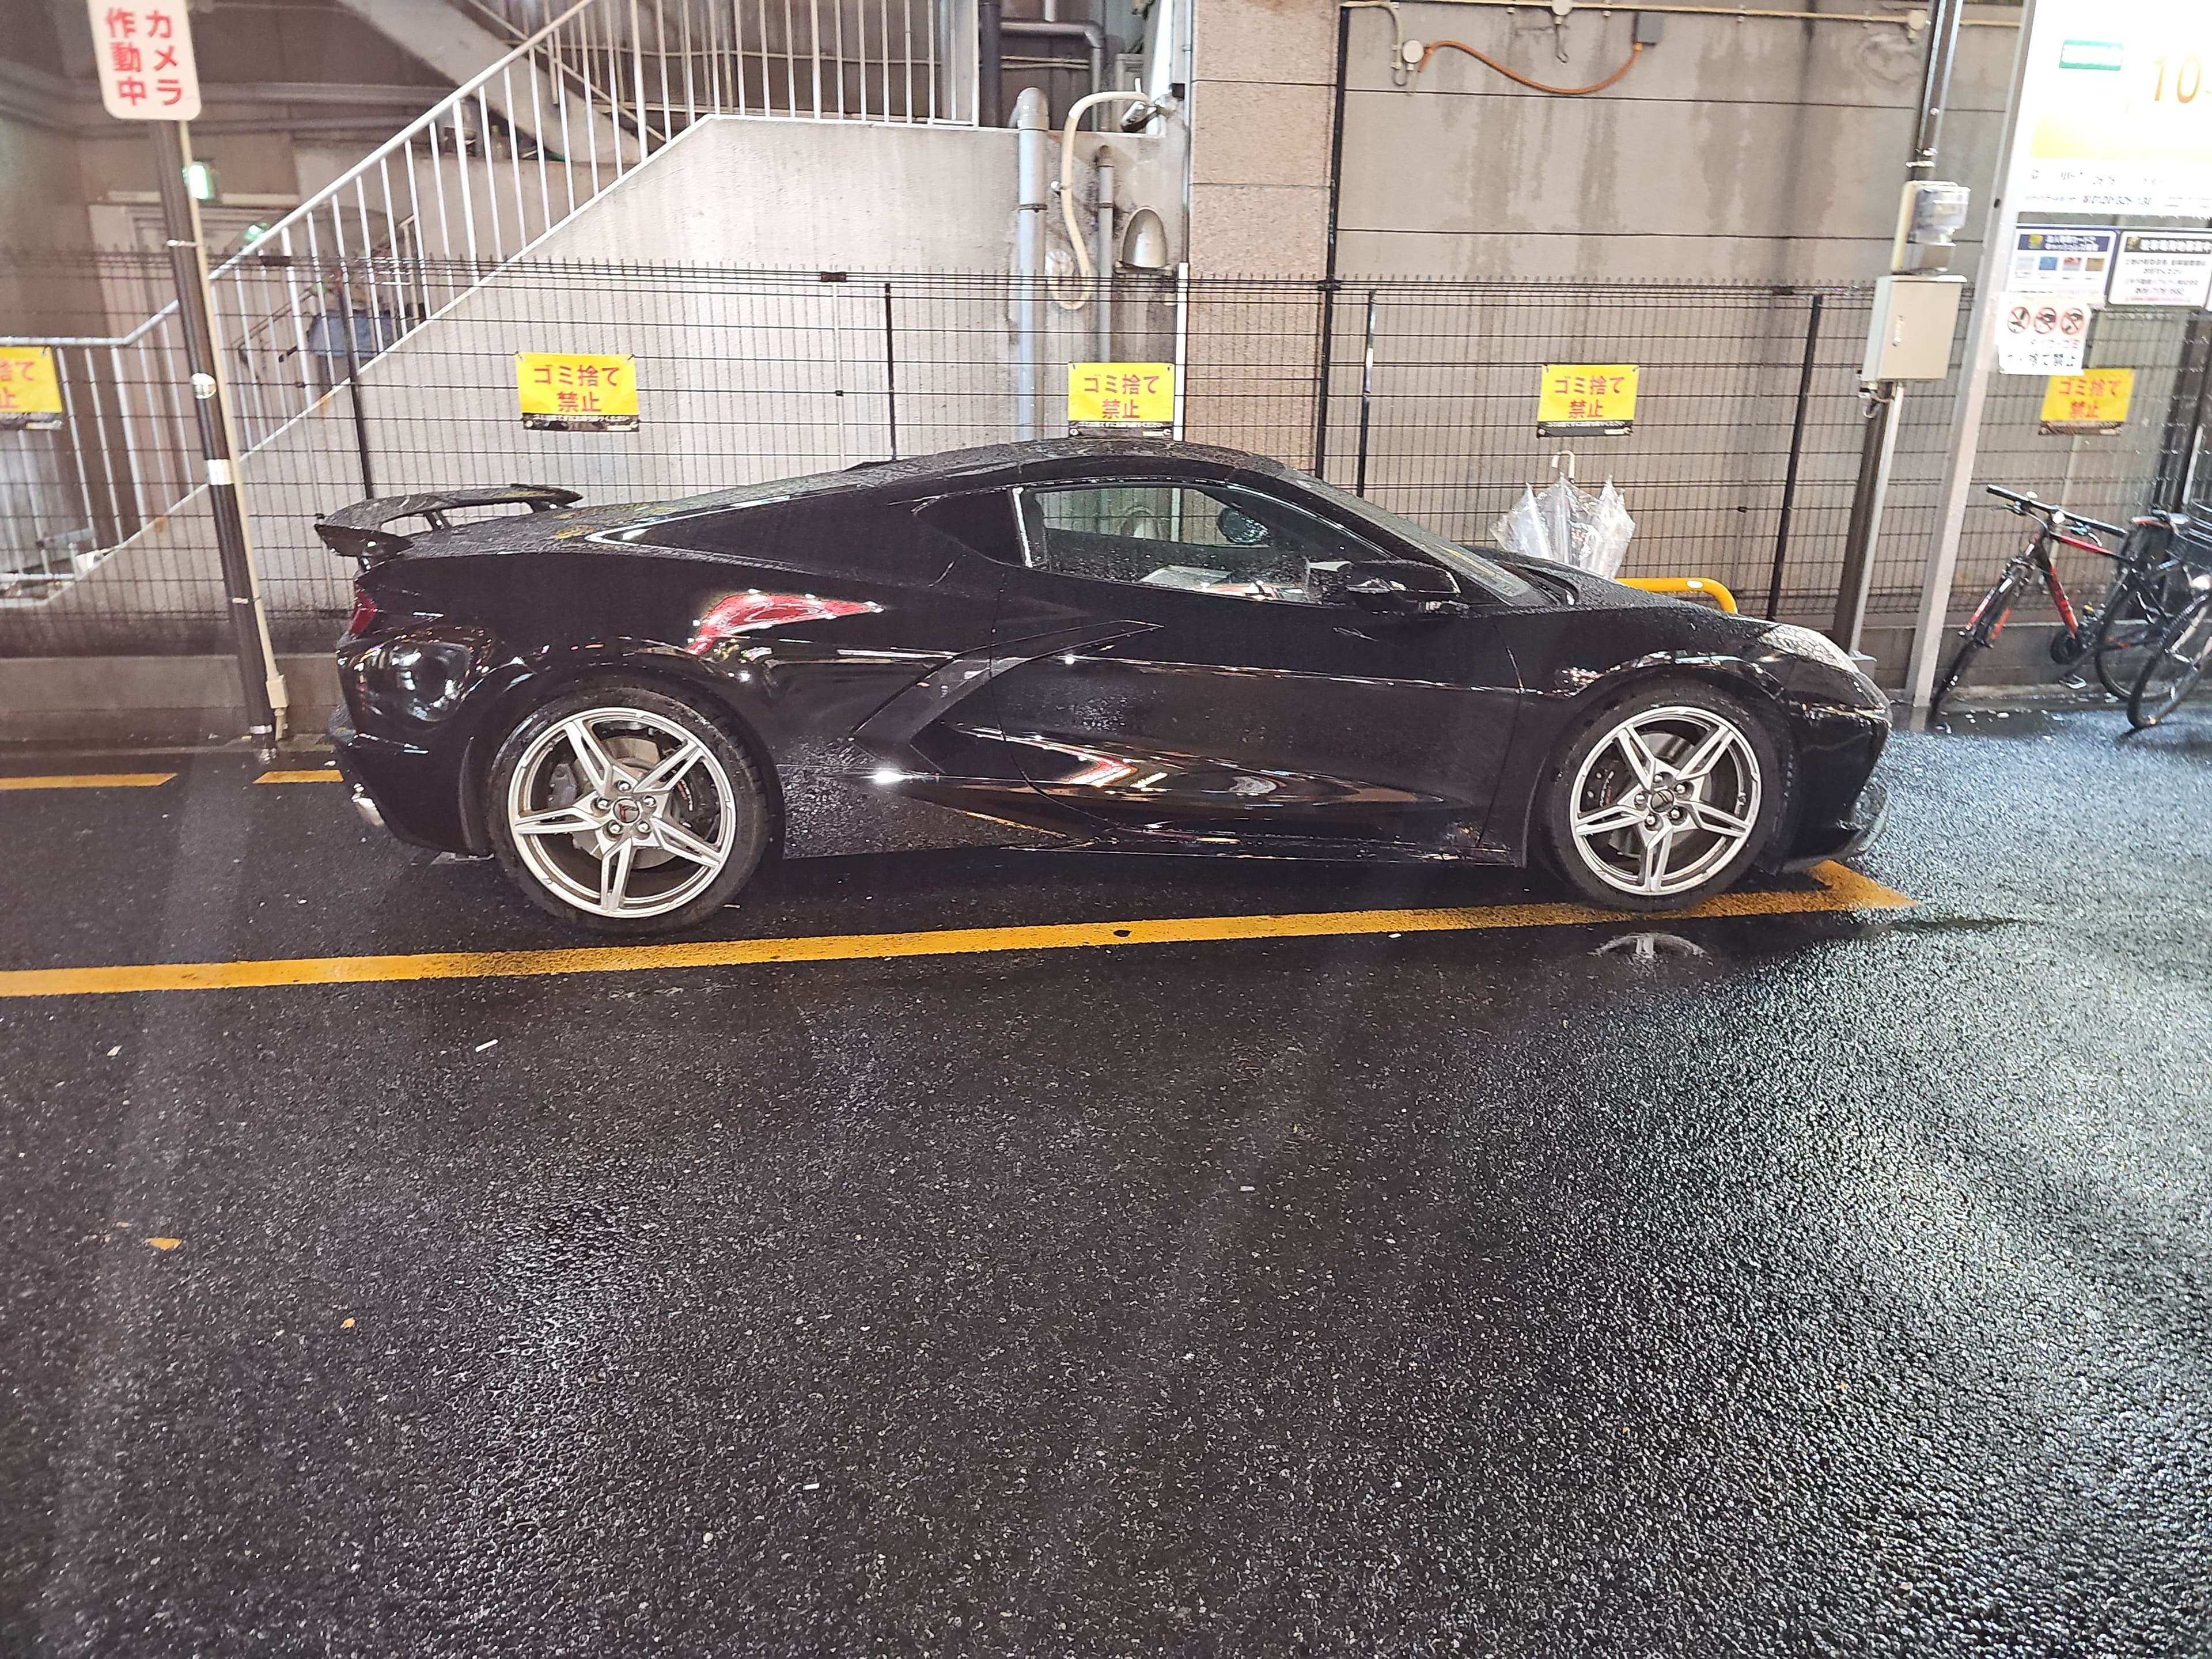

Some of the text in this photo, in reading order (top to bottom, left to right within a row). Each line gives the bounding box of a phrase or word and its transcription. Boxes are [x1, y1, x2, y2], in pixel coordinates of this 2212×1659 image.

[105, 8, 148, 107] 作動中
[146, 10, 184, 107] カメラ
[534, 363, 619, 387] ゴミ捨て
[1084, 373, 1160, 395] ゴミ捨て
[1555, 375, 1624, 395] ゴミ捨て
[2059, 377, 2122, 397] ゴミ捨て
[556, 391, 602, 412] 禁止
[1101, 399, 1141, 419] 禁止
[1568, 399, 1604, 419] 禁止
[2070, 400, 2100, 418] 禁止
